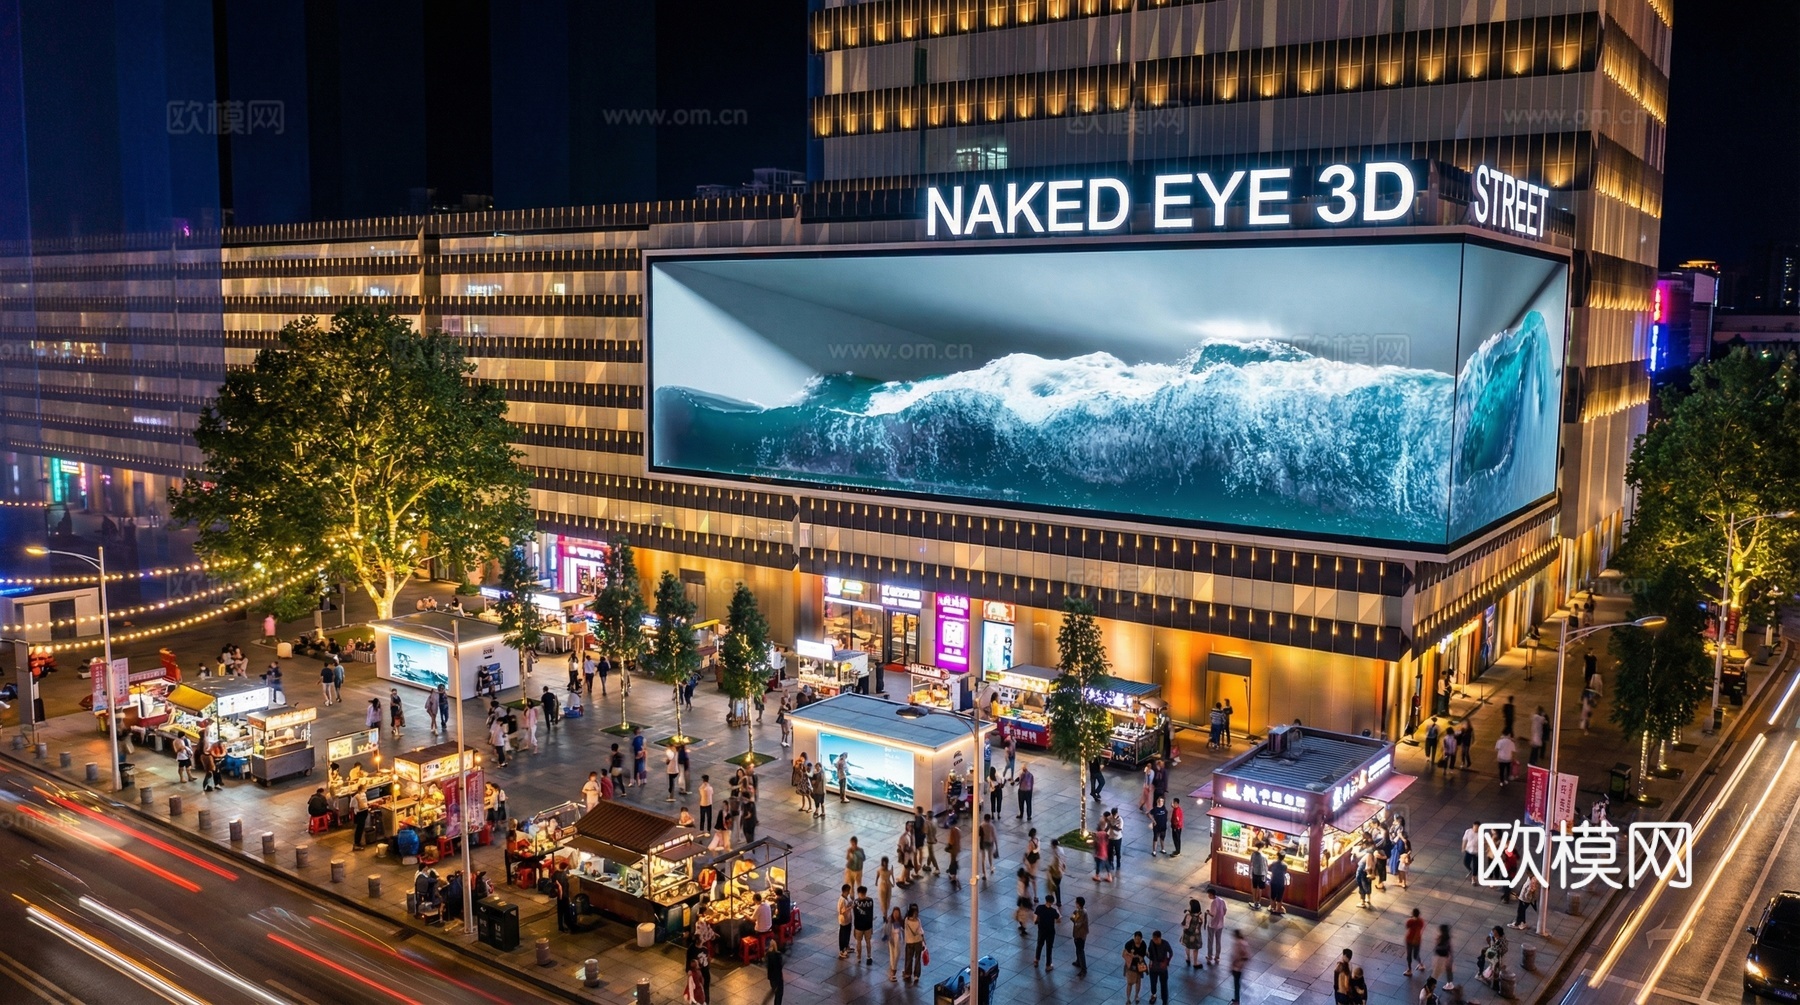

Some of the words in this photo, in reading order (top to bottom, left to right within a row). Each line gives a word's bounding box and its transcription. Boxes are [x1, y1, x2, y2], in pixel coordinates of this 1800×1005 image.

[927, 177, 1130, 237] NAKED
[1154, 167, 1291, 228] EYE
[1316, 161, 1415, 224] 3D
[1474, 164, 1550, 238] STREET
